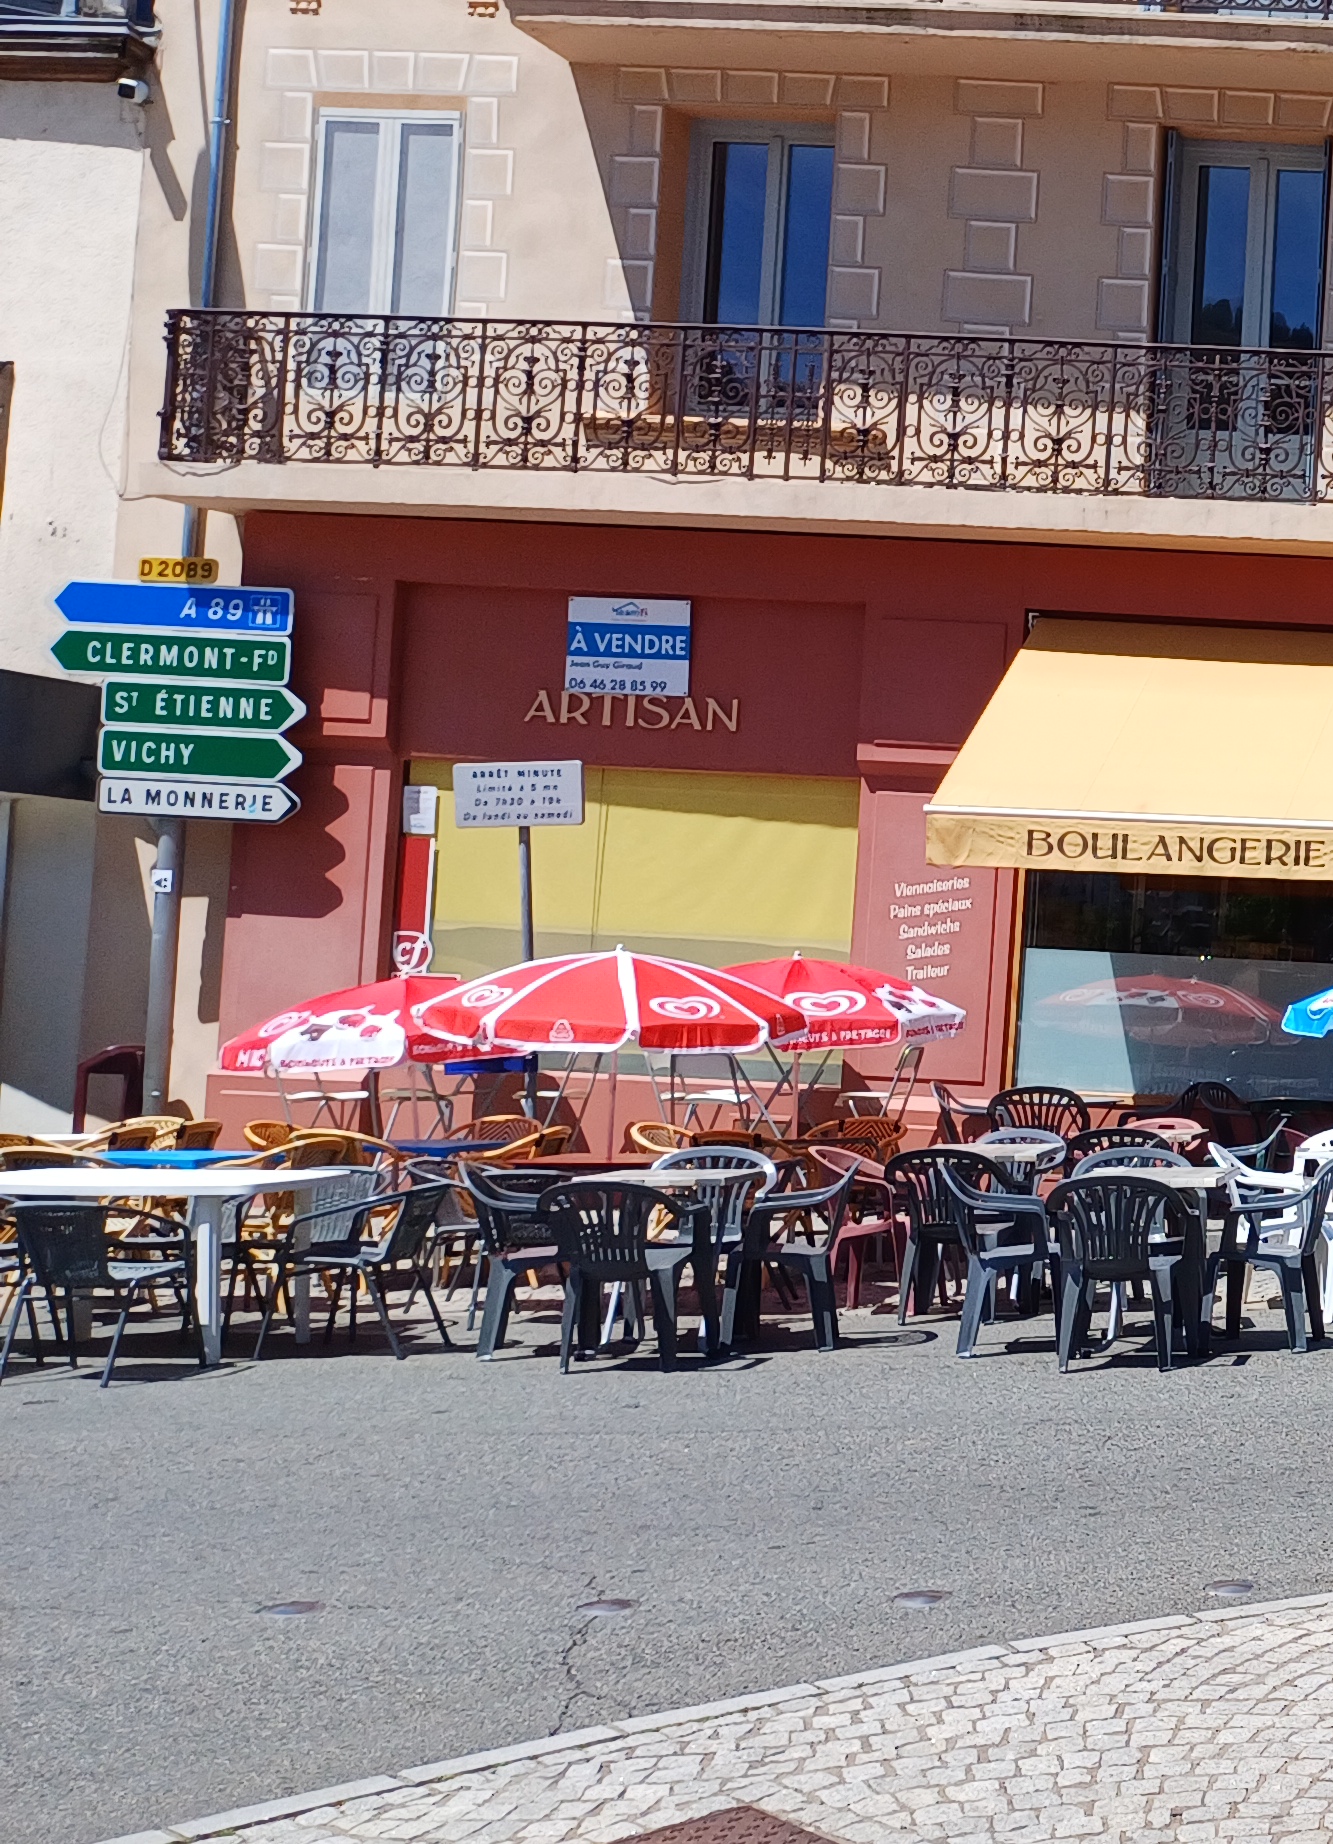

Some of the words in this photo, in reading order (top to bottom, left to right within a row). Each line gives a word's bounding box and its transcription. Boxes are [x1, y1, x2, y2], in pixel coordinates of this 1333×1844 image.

[157, 560, 213, 579] 2089
[180, 598, 197, 619] A
[208, 599, 243, 621] 89
[570, 625, 588, 652] À
[594, 632, 687, 656] VENDRE
[569, 678, 586, 690] 06
[590, 678, 606, 691] 46
[610, 679, 626, 691] 28
[650, 680, 667, 692] 99
[155, 690, 273, 720] ÉTIENNE
[523, 690, 739, 732] ARTISAN
[112, 740, 195, 765] VICHY
[107, 787, 133, 805] LA
[145, 789, 273, 812] MONNERIE
[1026, 829, 1326, 868] BOULANGERIE
[889, 904, 921, 920] Pains
[924, 898, 973, 918] spéciaux
[899, 917, 961, 940] Sandwichs
[906, 941, 951, 960] Salades
[906, 964, 950, 981] Traiteur
